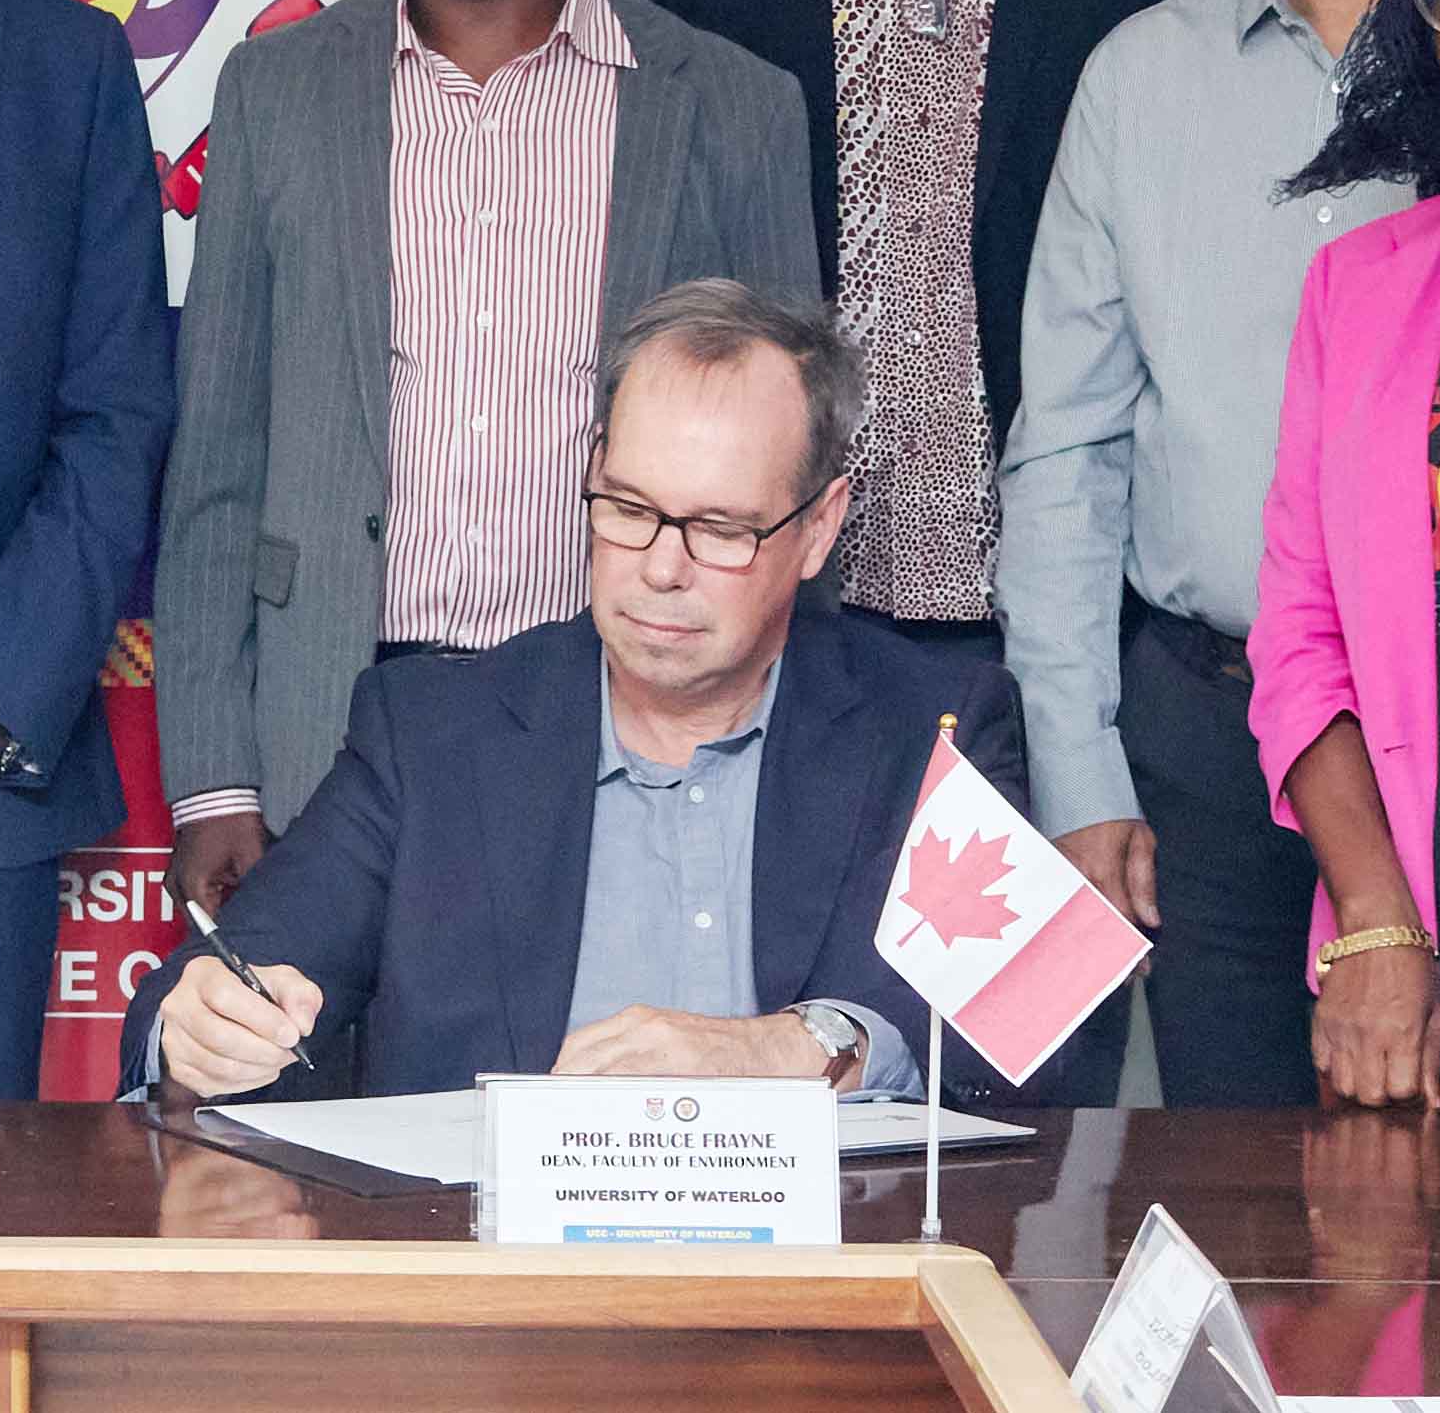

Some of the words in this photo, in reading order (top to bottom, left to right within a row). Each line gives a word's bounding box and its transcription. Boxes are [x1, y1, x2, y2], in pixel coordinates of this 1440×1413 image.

[562, 1131, 620, 1148] PROF.
[628, 1132, 695, 1149] BRUCE
[703, 1133, 777, 1149] FRAYNE
[541, 1154, 586, 1169] DEAN,
[592, 1155, 658, 1168] FACULTY
[664, 1155, 683, 1168] OF
[689, 1156, 798, 1169] ENVIRONMENT
[555, 1189, 659, 1203] UNIVERSITY
[665, 1190, 687, 1203] OF
[692, 1190, 786, 1204] WATERLOO
